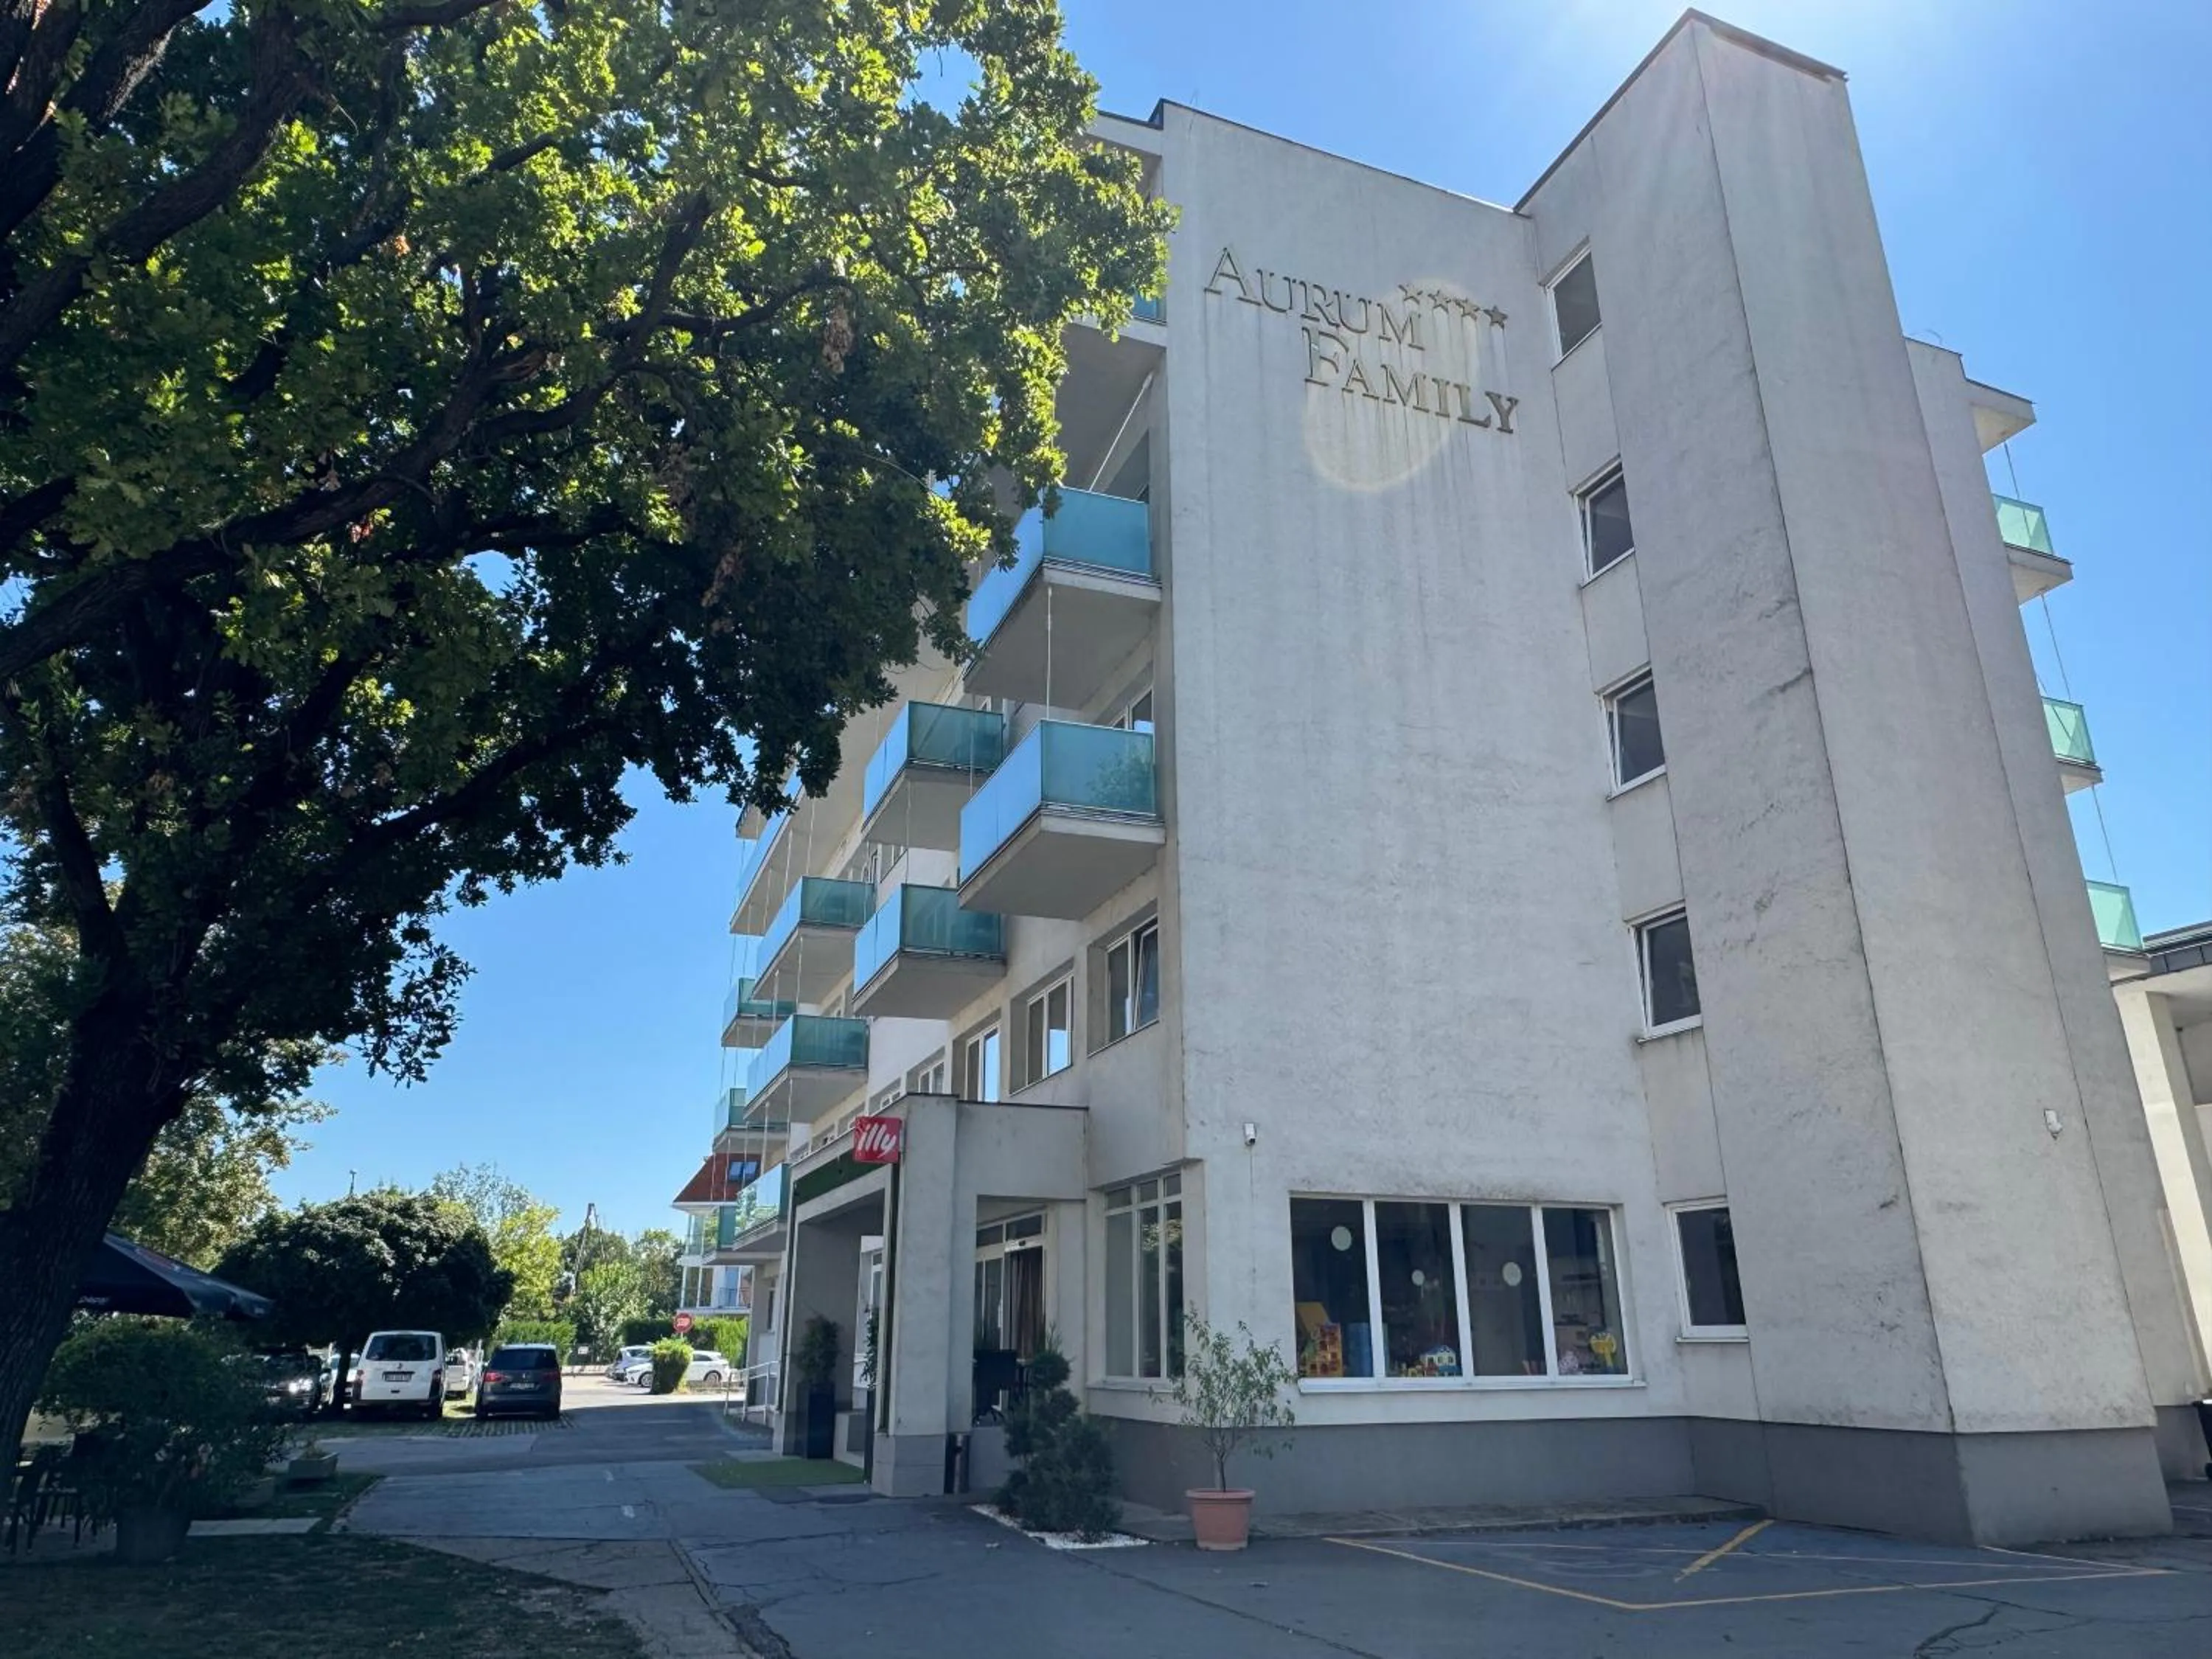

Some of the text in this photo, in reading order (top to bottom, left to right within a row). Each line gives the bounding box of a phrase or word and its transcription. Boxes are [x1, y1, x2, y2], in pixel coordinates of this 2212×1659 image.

[1204, 248, 1425, 350] AURUM
[1302, 327, 1519, 434] FAMILY
[857, 1123, 897, 1158] illy
